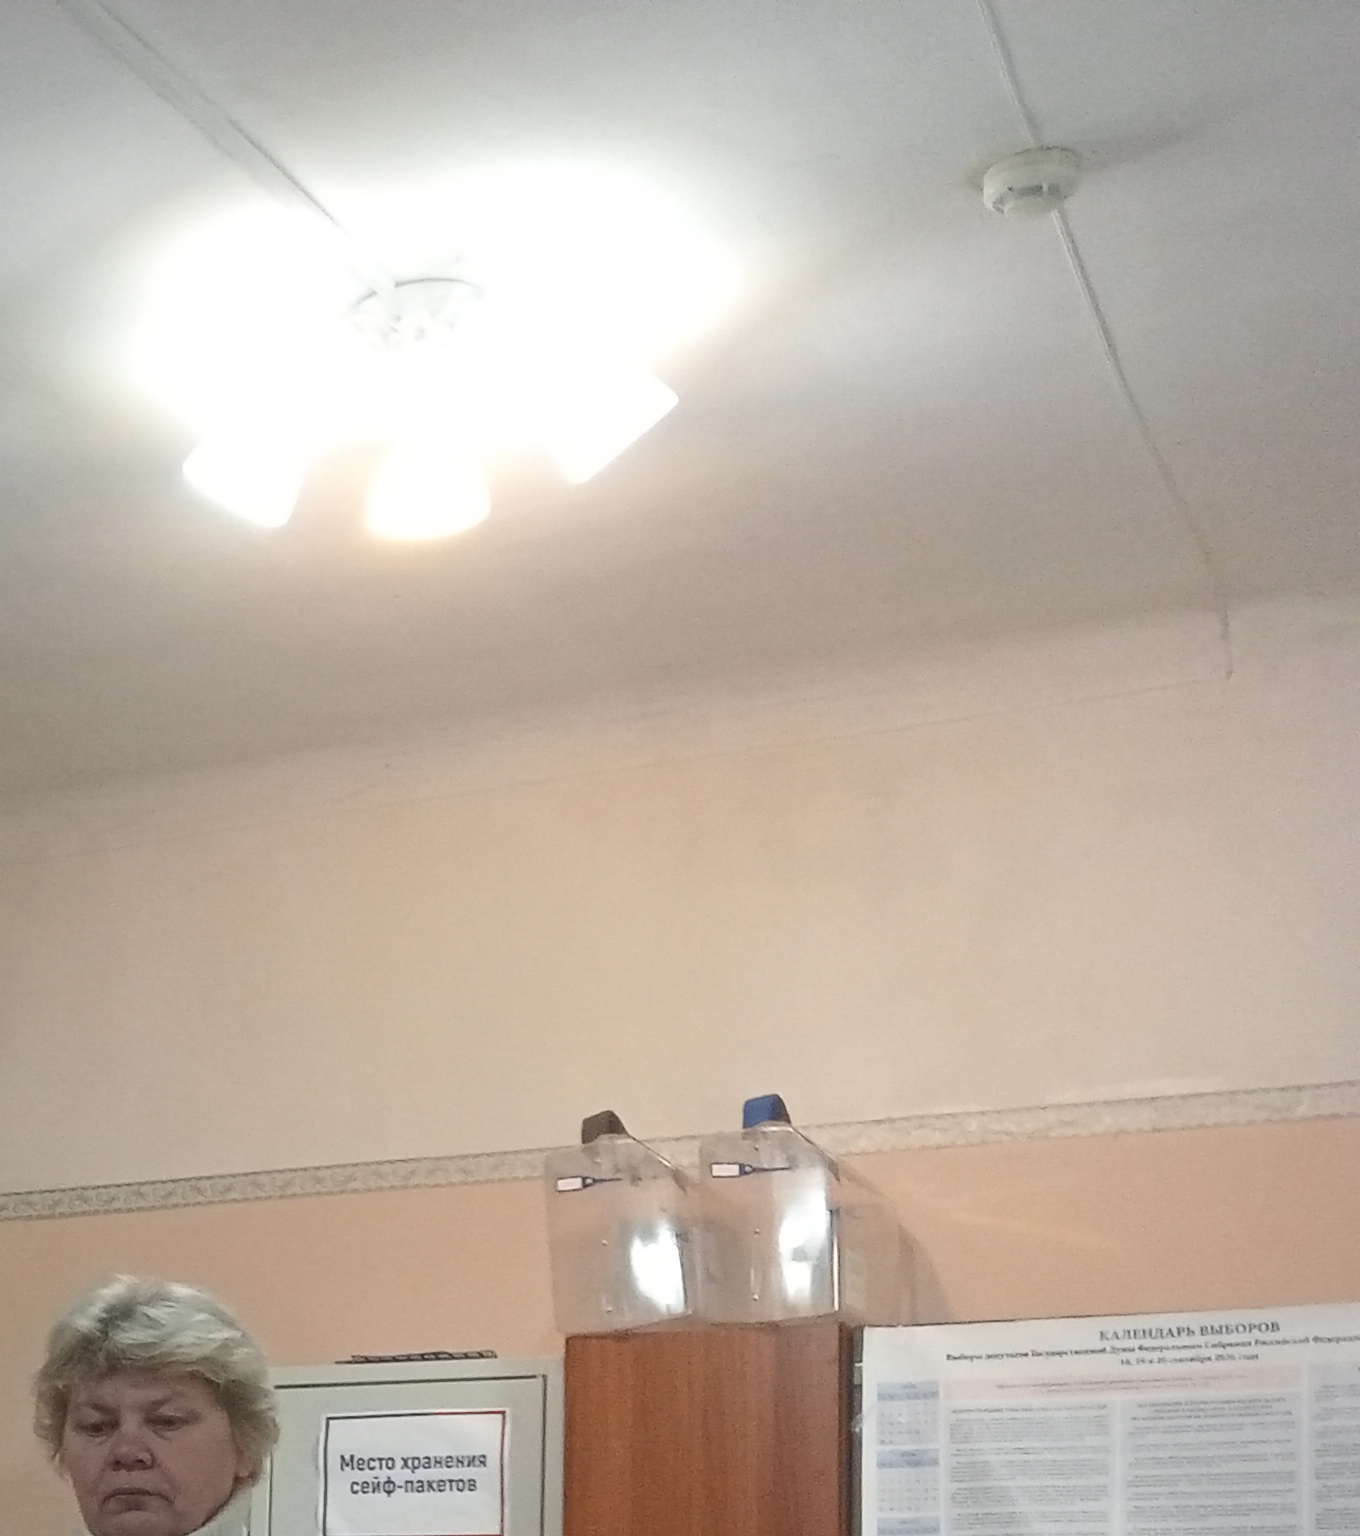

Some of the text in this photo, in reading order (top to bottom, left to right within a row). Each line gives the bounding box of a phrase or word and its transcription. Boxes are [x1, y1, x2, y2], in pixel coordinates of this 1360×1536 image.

[1099, 1321, 1280, 1341] КАЛЕНДАРЬ ВЫБОРОВ
[340, 1453, 488, 1474] Место хранения
[350, 1475, 477, 1498] сейф-пакетов
